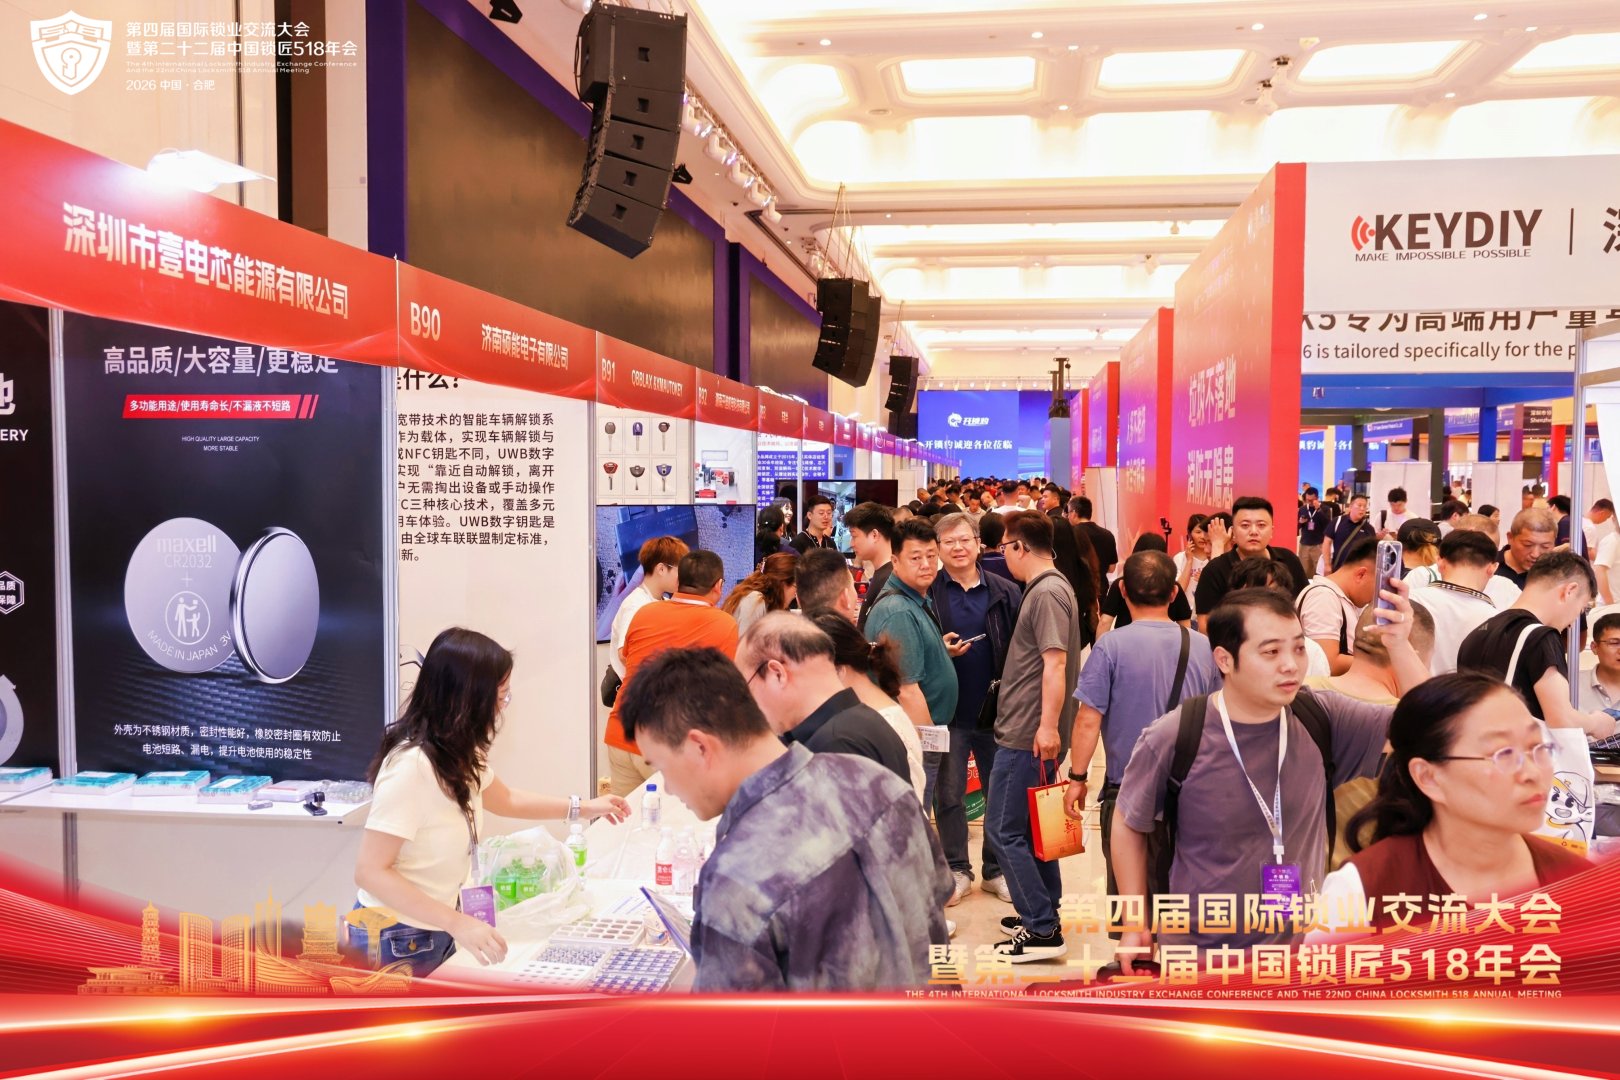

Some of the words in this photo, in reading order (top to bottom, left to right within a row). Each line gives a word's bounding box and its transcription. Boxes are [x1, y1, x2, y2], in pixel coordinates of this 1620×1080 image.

[1374, 209, 1543, 251] KEYDIY
[63, 202, 349, 319] 深圳市壹电芯能源有限公司
[1355, 252, 1389, 262] MAKE
[1395, 250, 1466, 261] IMPOSSIBLE
[1473, 248, 1531, 259] POSSIBLE
[410, 302, 441, 341] B90
[103, 346, 339, 377] 高品质/大容量/更稳定
[1317, 343, 1330, 359] is
[1334, 342, 1399, 359] tailored
[1404, 341, 1500, 362] specifically
[1505, 341, 1530, 357] for
[1534, 341, 1563, 357] the
[601, 357, 616, 384] B91
[1188, 354, 1237, 428] 垃圾不落地
[130, 399, 291, 413] 多功能用途/使用寿命长/不漏液不短路
[195, 435, 216, 443] QUALITY
[1187, 444, 1234, 510] 消防无隐患
[157, 534, 217, 553] maxell
[164, 554, 212, 569] CR2032
[147, 630, 174, 657] MADE
[174, 648, 185, 660] IN
[186, 644, 219, 661] JAPAN
